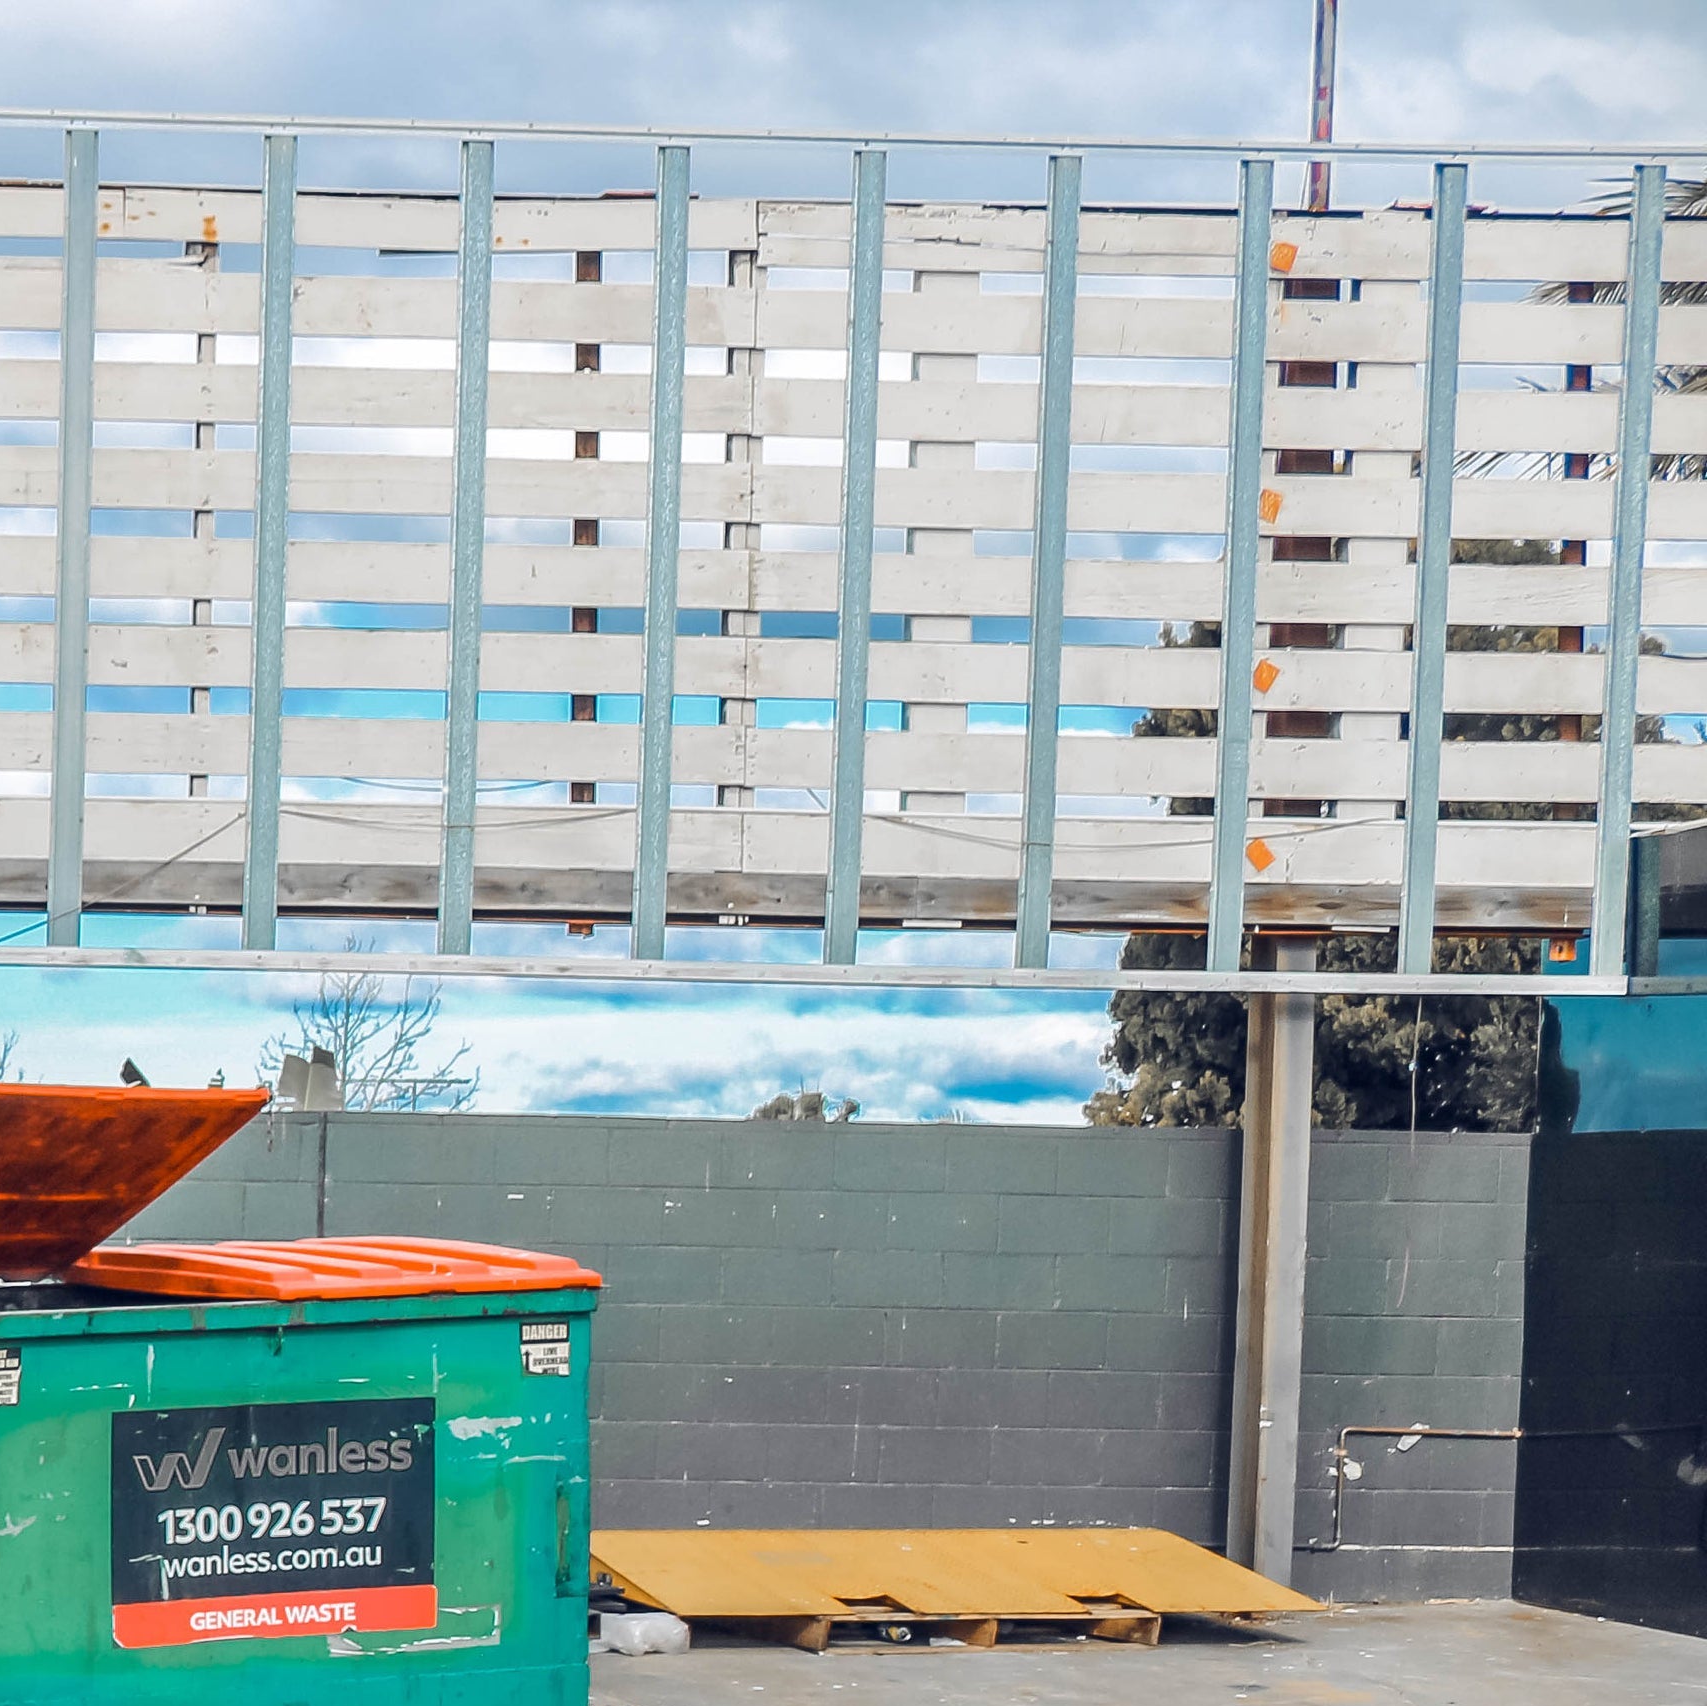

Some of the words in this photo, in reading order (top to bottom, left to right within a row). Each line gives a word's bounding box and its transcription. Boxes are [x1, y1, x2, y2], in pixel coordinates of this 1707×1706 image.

[522, 1324, 568, 1341] DANGER
[227, 1427, 412, 1478] wanless
[158, 1505, 243, 1545] 1300
[247, 1500, 314, 1539] 926
[320, 1496, 386, 1535] 537
[162, 1545, 382, 1579] wanless.com.au
[189, 1608, 283, 1631] GENERAL
[284, 1602, 356, 1625] WASTE
